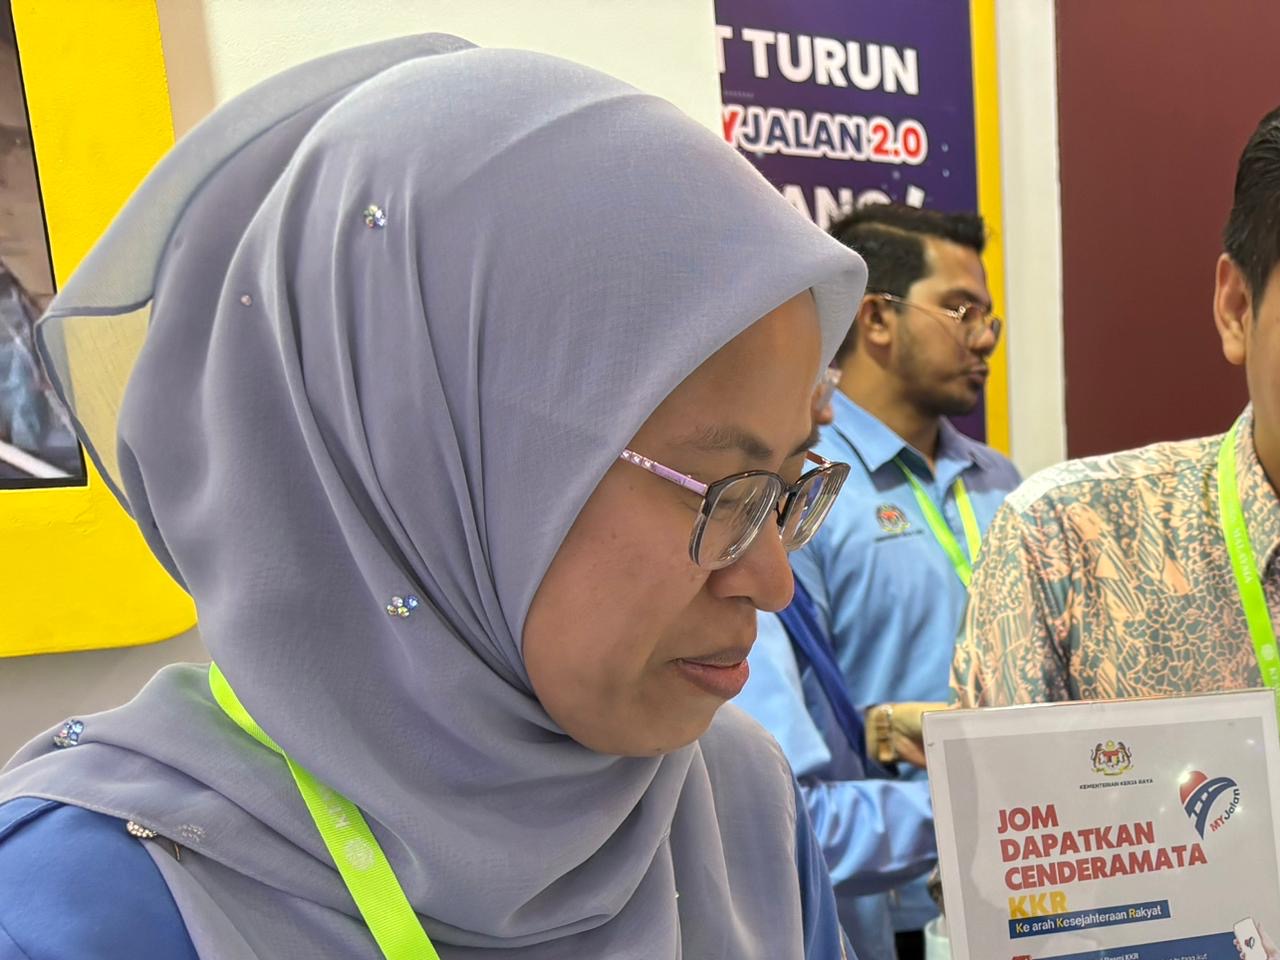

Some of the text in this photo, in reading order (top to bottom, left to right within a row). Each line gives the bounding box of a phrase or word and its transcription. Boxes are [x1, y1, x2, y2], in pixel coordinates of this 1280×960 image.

[741, 27, 920, 96] TURUN
[996, 804, 1060, 835] JOM
[1208, 788, 1241, 833] MYJalan
[1000, 821, 1156, 863] DAPATKAN
[1004, 842, 1209, 892] CENDERAMATA
[1007, 890, 1069, 920] KKR
[1015, 904, 1162, 934] Ke arah Kesejahteraan Rakyat
